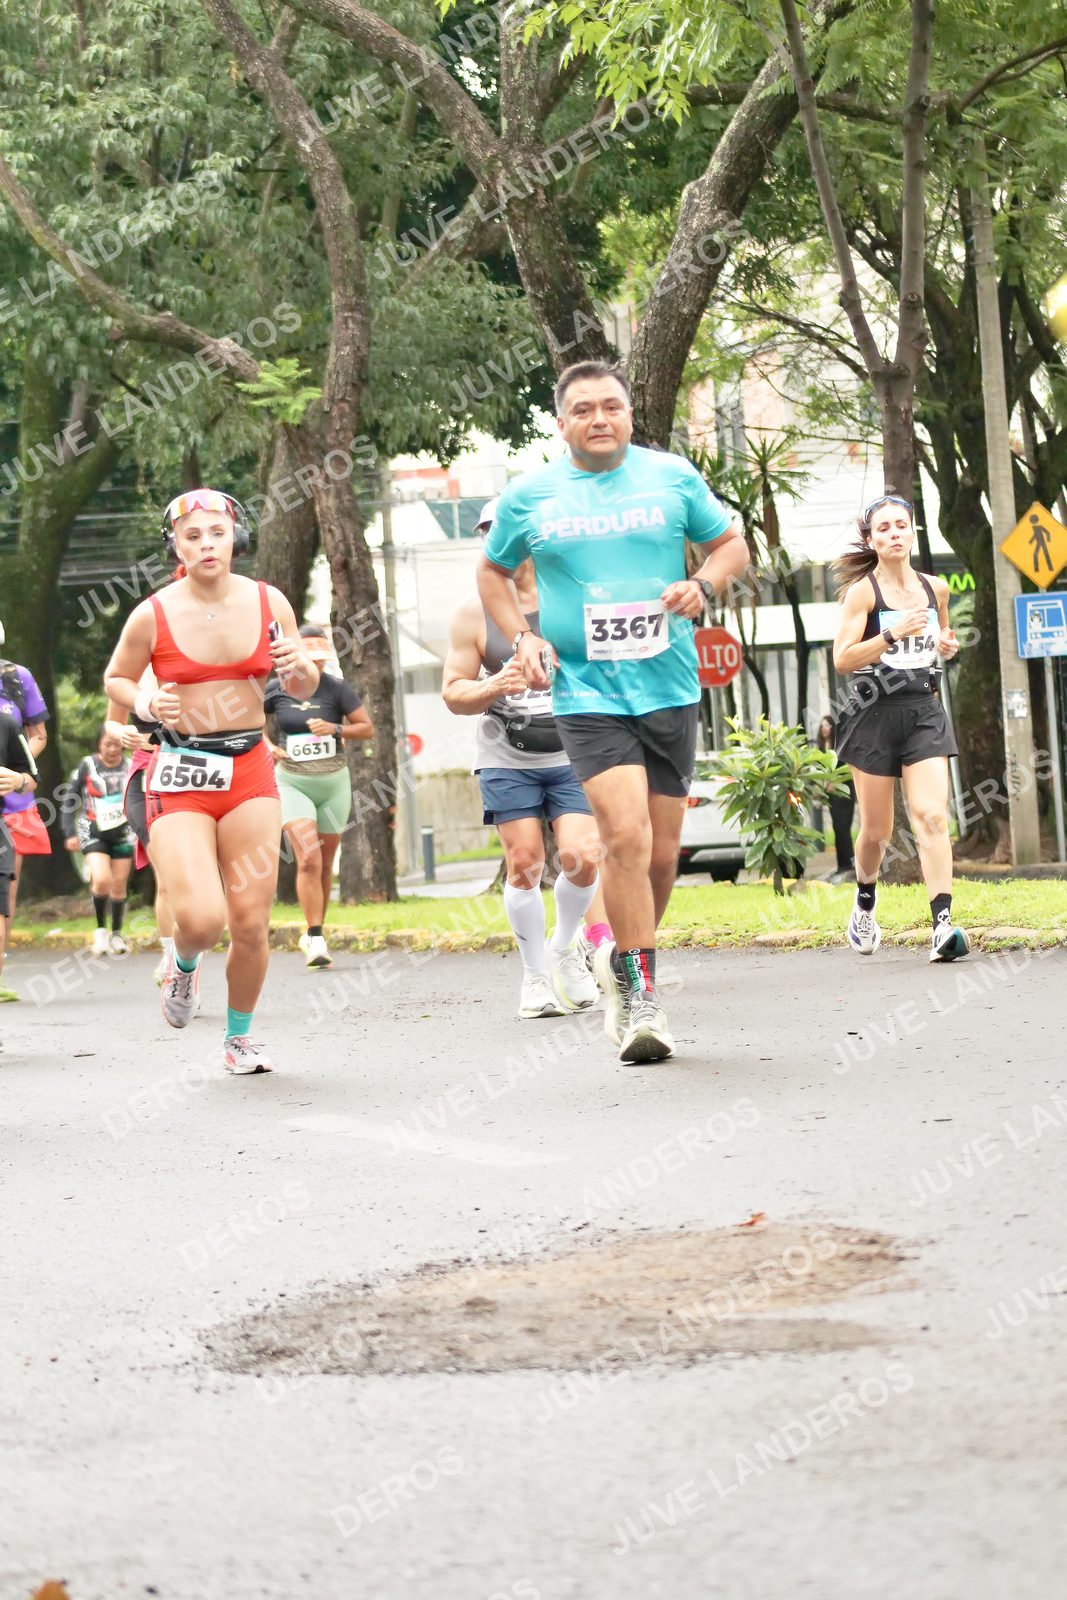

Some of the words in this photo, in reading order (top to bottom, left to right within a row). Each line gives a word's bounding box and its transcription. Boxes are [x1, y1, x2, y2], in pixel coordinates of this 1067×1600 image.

[539, 506, 666, 540] PERDURA
[591, 613, 664, 642] 3367
[698, 643, 738, 669] LTO
[292, 741, 330, 756] 6631
[160, 765, 225, 789] 6504
